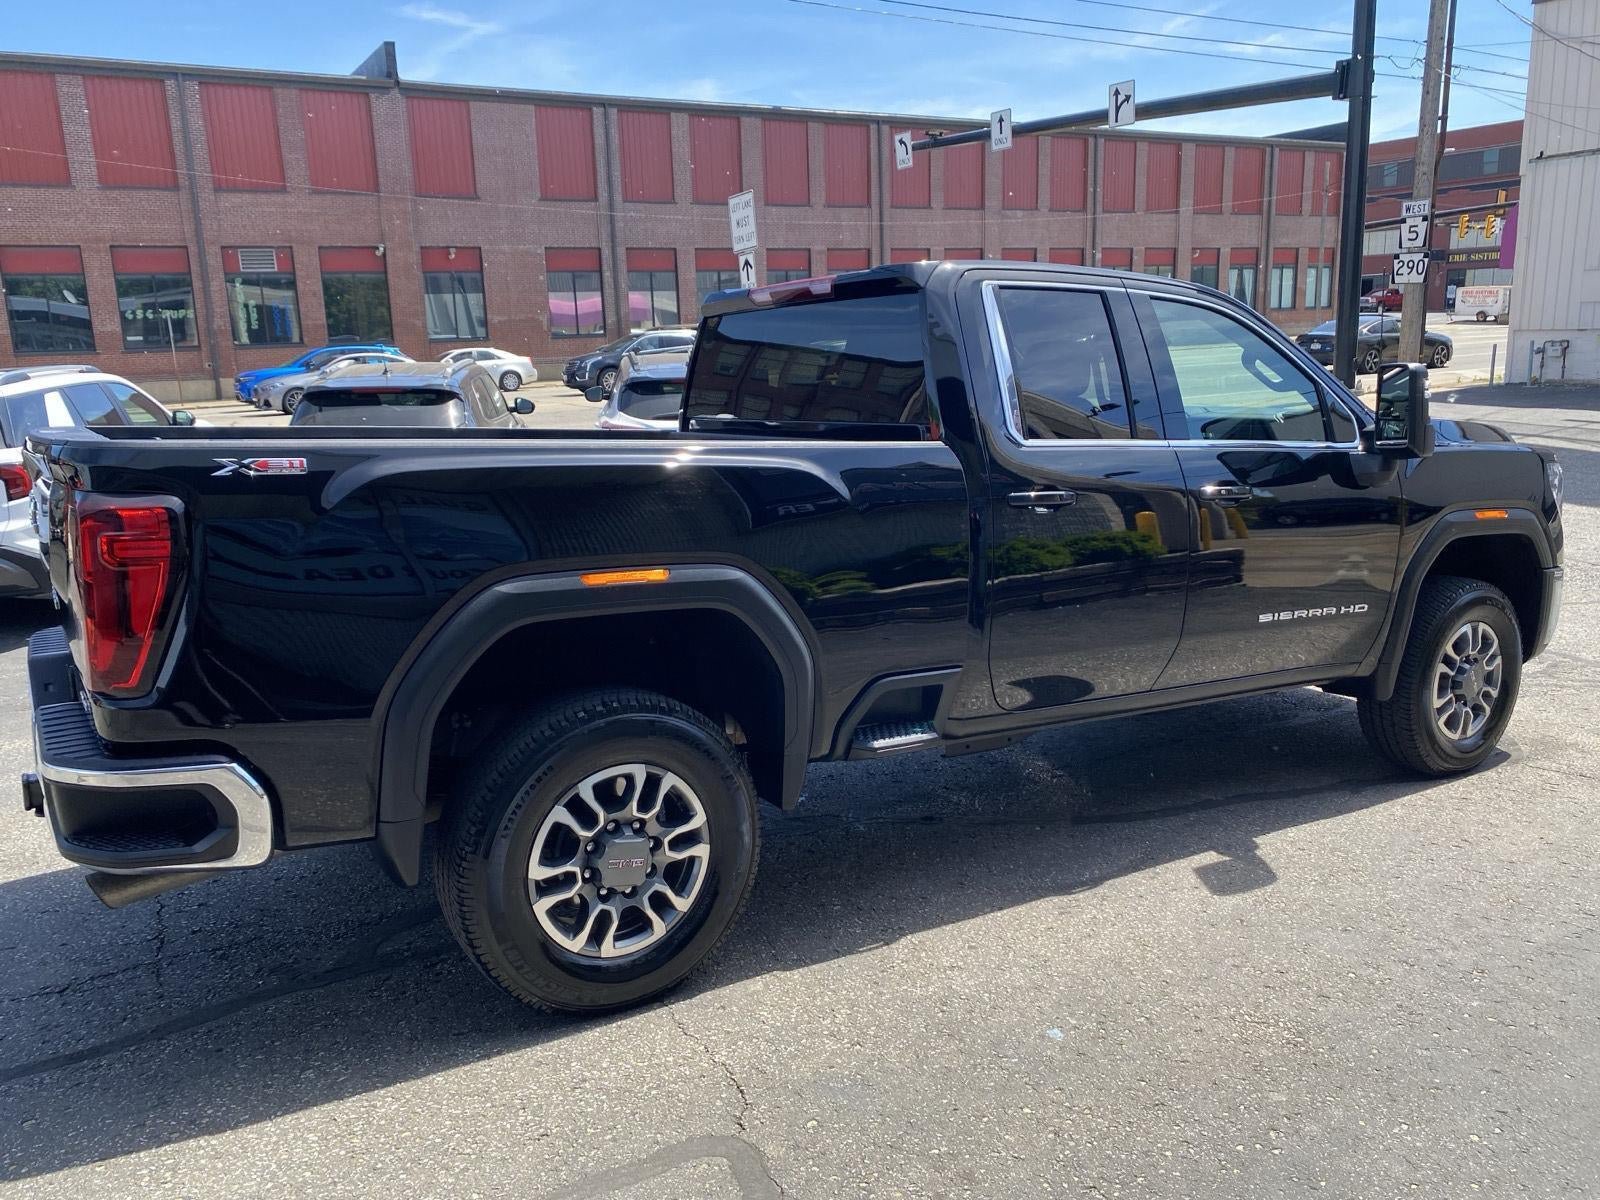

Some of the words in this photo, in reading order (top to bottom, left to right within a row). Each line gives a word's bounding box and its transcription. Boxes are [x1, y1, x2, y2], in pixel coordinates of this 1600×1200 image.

[994, 136, 1009, 146] ONLY
[742, 198, 752, 210] LANE
[1405, 203, 1427, 214] WEST
[736, 215, 750, 229] MUST
[1408, 225, 1419, 241] 5
[1396, 259, 1425, 276] 290
[1258, 606, 1337, 623] SIERRA
[1340, 603, 1369, 614] HD
